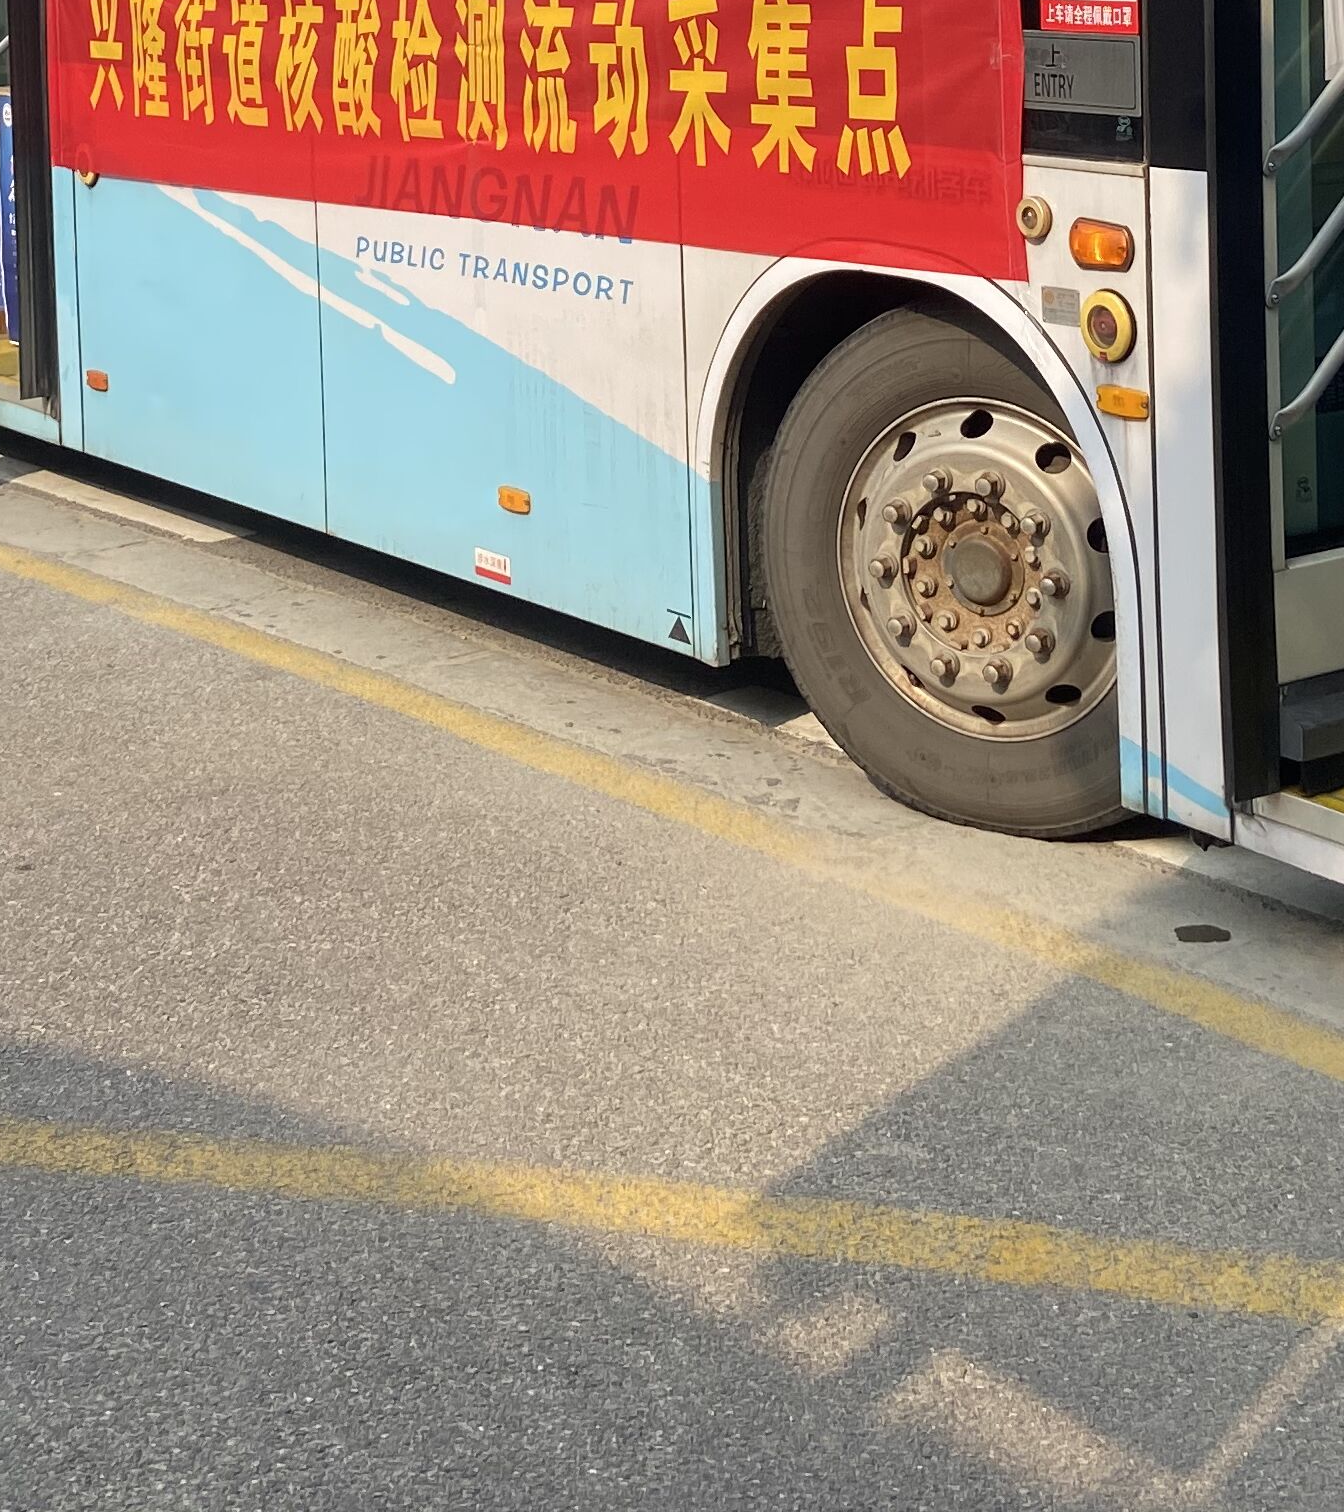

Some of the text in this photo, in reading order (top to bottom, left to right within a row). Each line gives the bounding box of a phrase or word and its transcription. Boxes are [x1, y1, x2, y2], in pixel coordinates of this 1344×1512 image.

[1045, 3, 1133, 27] 上车请全程佩戴口罩
[1045, 43, 1061, 68] 上
[1034, 72, 1075, 99] ENTRY
[355, 153, 641, 245] JIANGNAN
[356, 235, 634, 305] PUBLIC TRANSPORT
